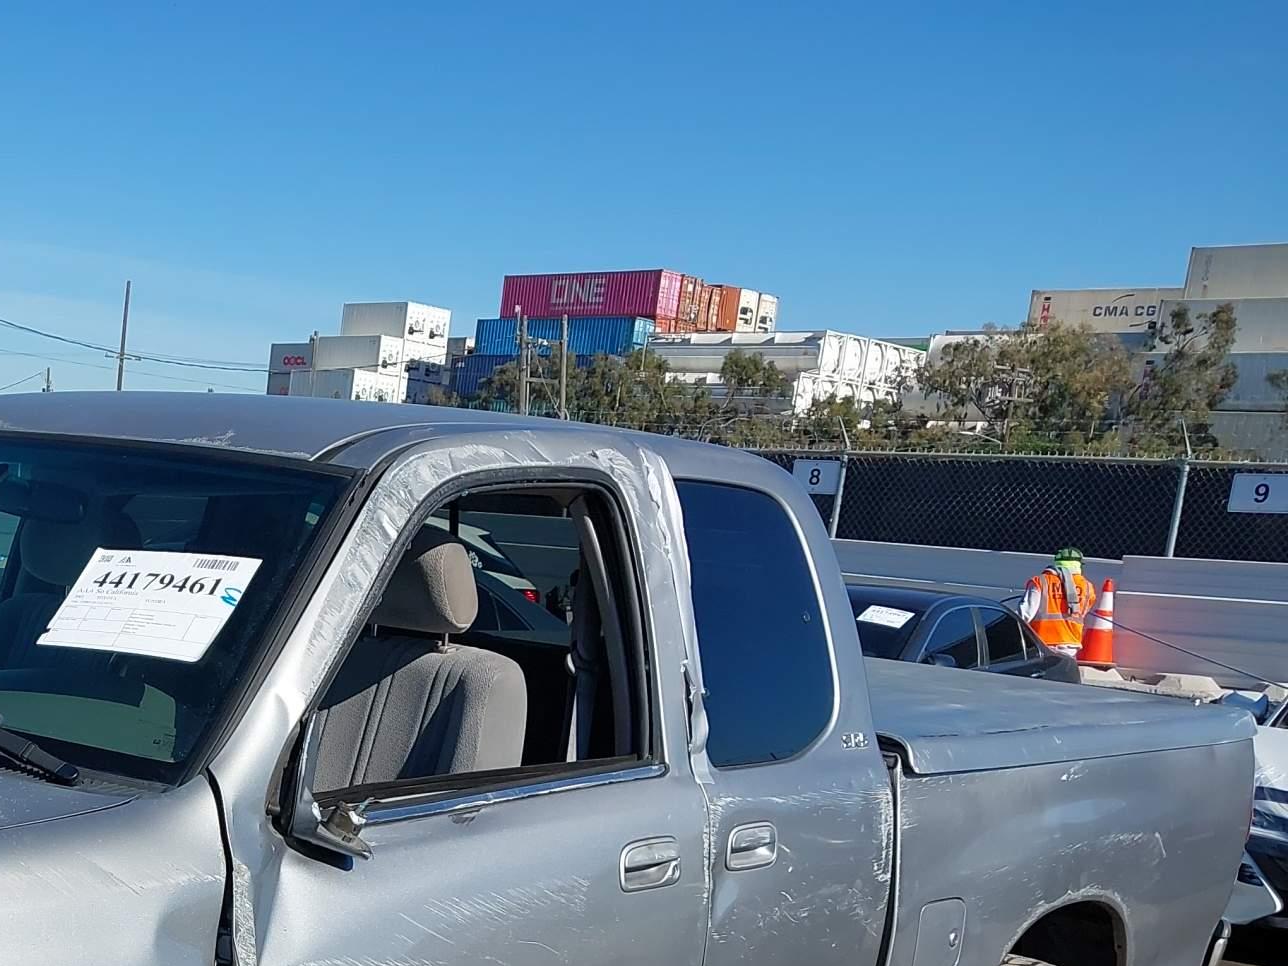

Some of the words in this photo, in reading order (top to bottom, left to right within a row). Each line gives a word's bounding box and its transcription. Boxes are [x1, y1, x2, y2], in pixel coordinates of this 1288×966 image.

[551, 277, 606, 304] ONE
[1092, 305, 1129, 317] CMA
[1134, 305, 1157, 317] CG
[808, 468, 821, 486] 8
[1253, 483, 1270, 504] 9
[93, 570, 223, 596] 44179461
